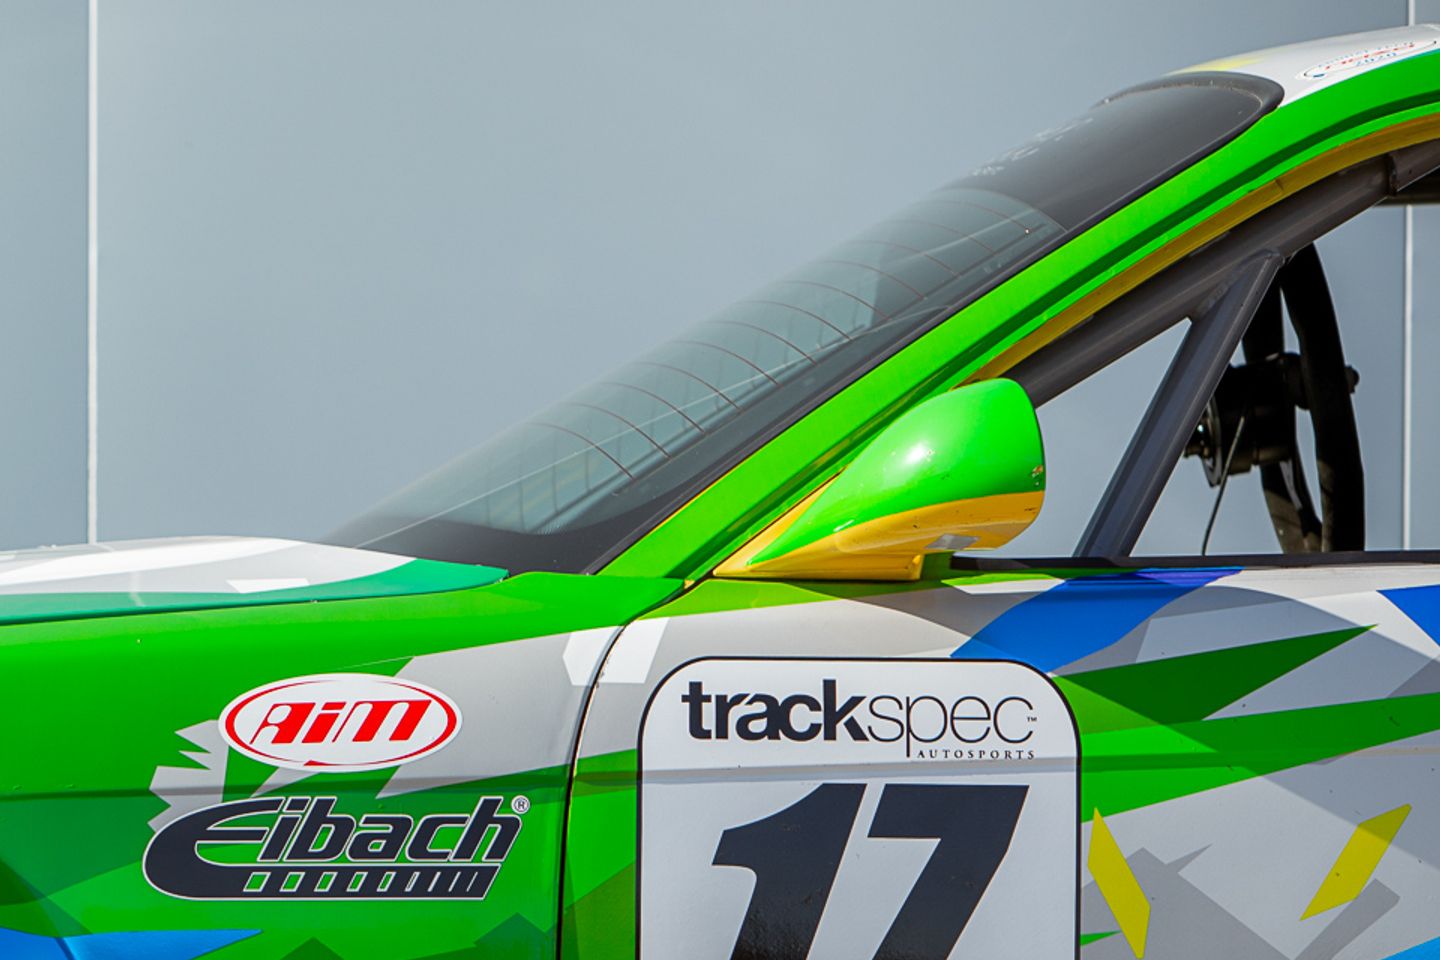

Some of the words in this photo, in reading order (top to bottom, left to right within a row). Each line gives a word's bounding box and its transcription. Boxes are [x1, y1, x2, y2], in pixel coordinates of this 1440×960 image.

[681, 678, 1033, 757] trackspec
[917, 749, 1035, 760] AUTOSPORTS
[142, 797, 523, 900] Eibach
